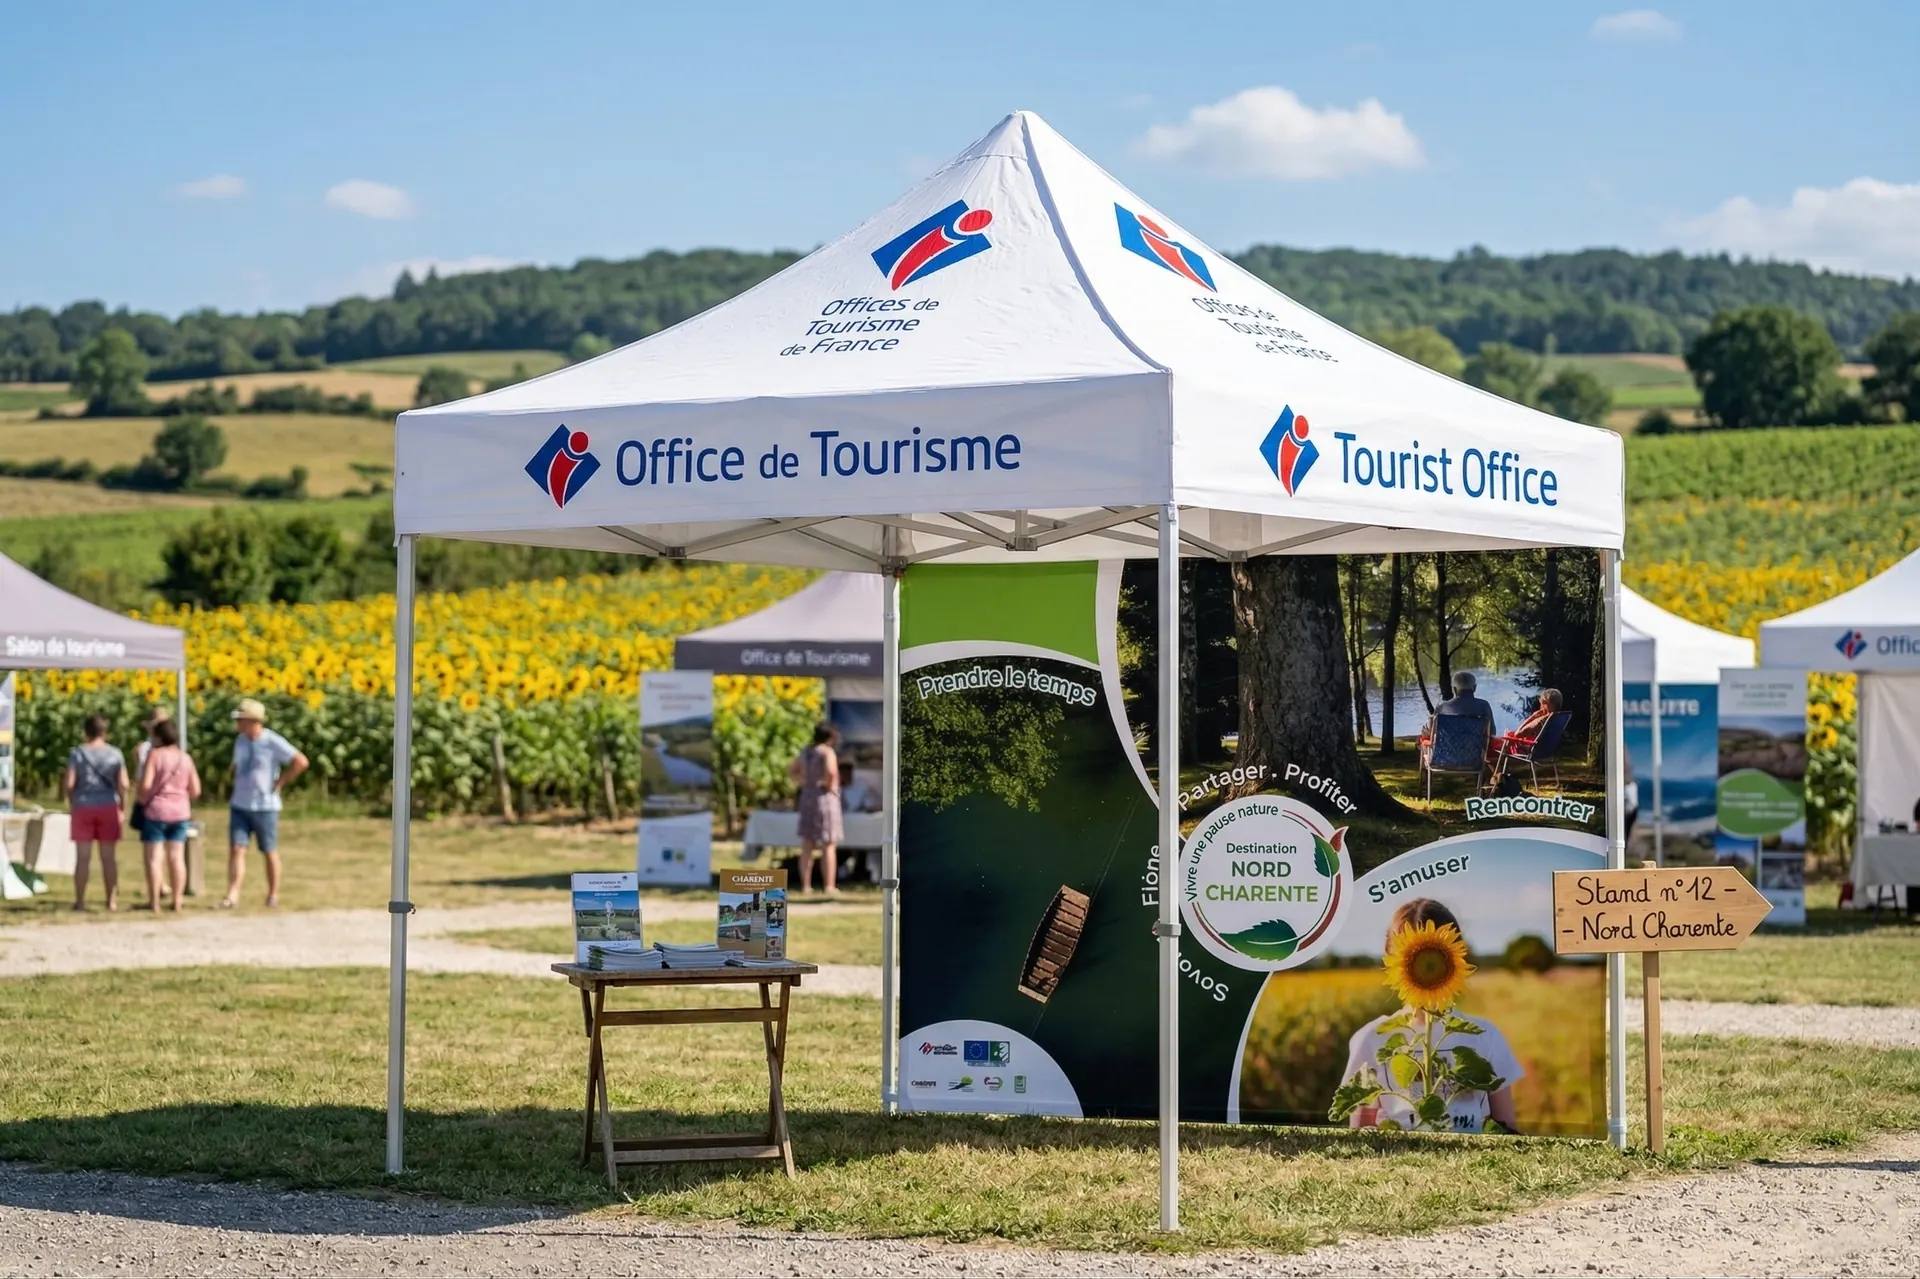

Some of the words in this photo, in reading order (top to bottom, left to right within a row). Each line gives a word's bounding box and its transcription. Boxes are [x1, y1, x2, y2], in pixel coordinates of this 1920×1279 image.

[821, 297, 911, 316] Offices
[913, 298, 940, 311] de
[805, 316, 921, 336] Tourisme
[780, 343, 806, 356] de
[810, 338, 899, 354] France
[616, 437, 744, 486] Office
[759, 443, 799, 479] de
[810, 426, 1021, 477] Tourisme
[1334, 431, 1453, 495] Tourist
[1462, 448, 1558, 506] Office
[6, 635, 45, 657] Salon
[46, 636, 66, 657] de
[741, 648, 782, 666] Office
[784, 649, 803, 666] de
[804, 649, 871, 667] Tourisme
[917, 666, 1003, 699] Prendre
[1005, 665, 1027, 688] le
[1027, 668, 1097, 706] temps
[1177, 764, 1267, 811] Partager
[1284, 762, 1357, 815] Profiter
[1238, 803, 1278, 818] nature
[1464, 796, 1595, 823] Rencontrer
[1203, 811, 1236, 844] pause
[1190, 840, 1207, 865] une
[1226, 842, 1297, 854] Destination
[732, 875, 774, 883] CHARENTE
[1231, 861, 1292, 877] NORD
[1368, 855, 1469, 903] S'amuser
[1184, 866, 1198, 902] Vivre
[1205, 884, 1318, 902] CHARENTE
[1575, 876, 1651, 906] Stand
[1582, 912, 1637, 941] Nord
[1642, 910, 1738, 939] Charente
